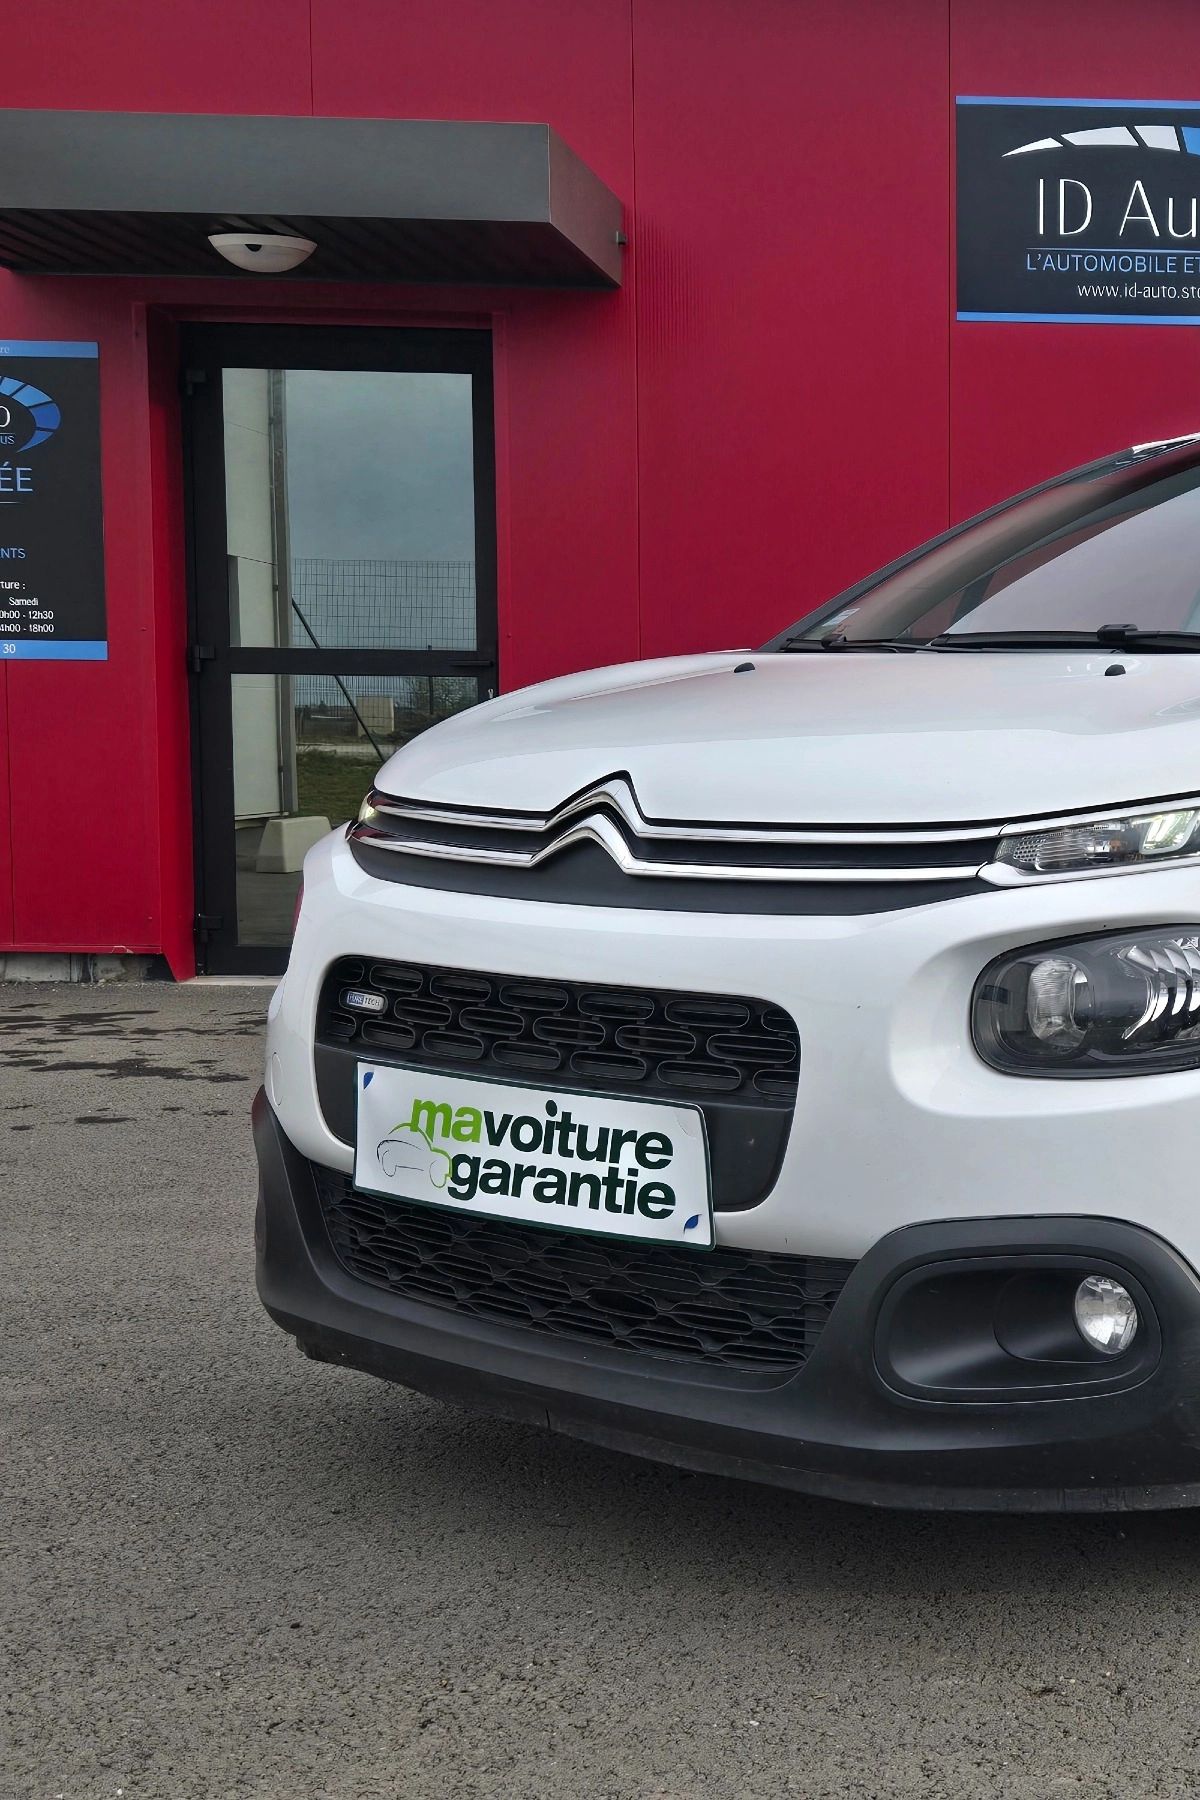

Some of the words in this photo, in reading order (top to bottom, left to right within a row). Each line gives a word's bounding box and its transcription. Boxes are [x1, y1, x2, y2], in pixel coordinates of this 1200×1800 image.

[1038, 178, 1093, 236] ID
[0, 547, 26, 559] NTS
[8, 596, 39, 606] Samedi
[28, 610, 54, 620] 12h30
[29, 623, 55, 633] 18h00
[2, 643, 16, 654] 30
[447, 1151, 677, 1220] garantie
